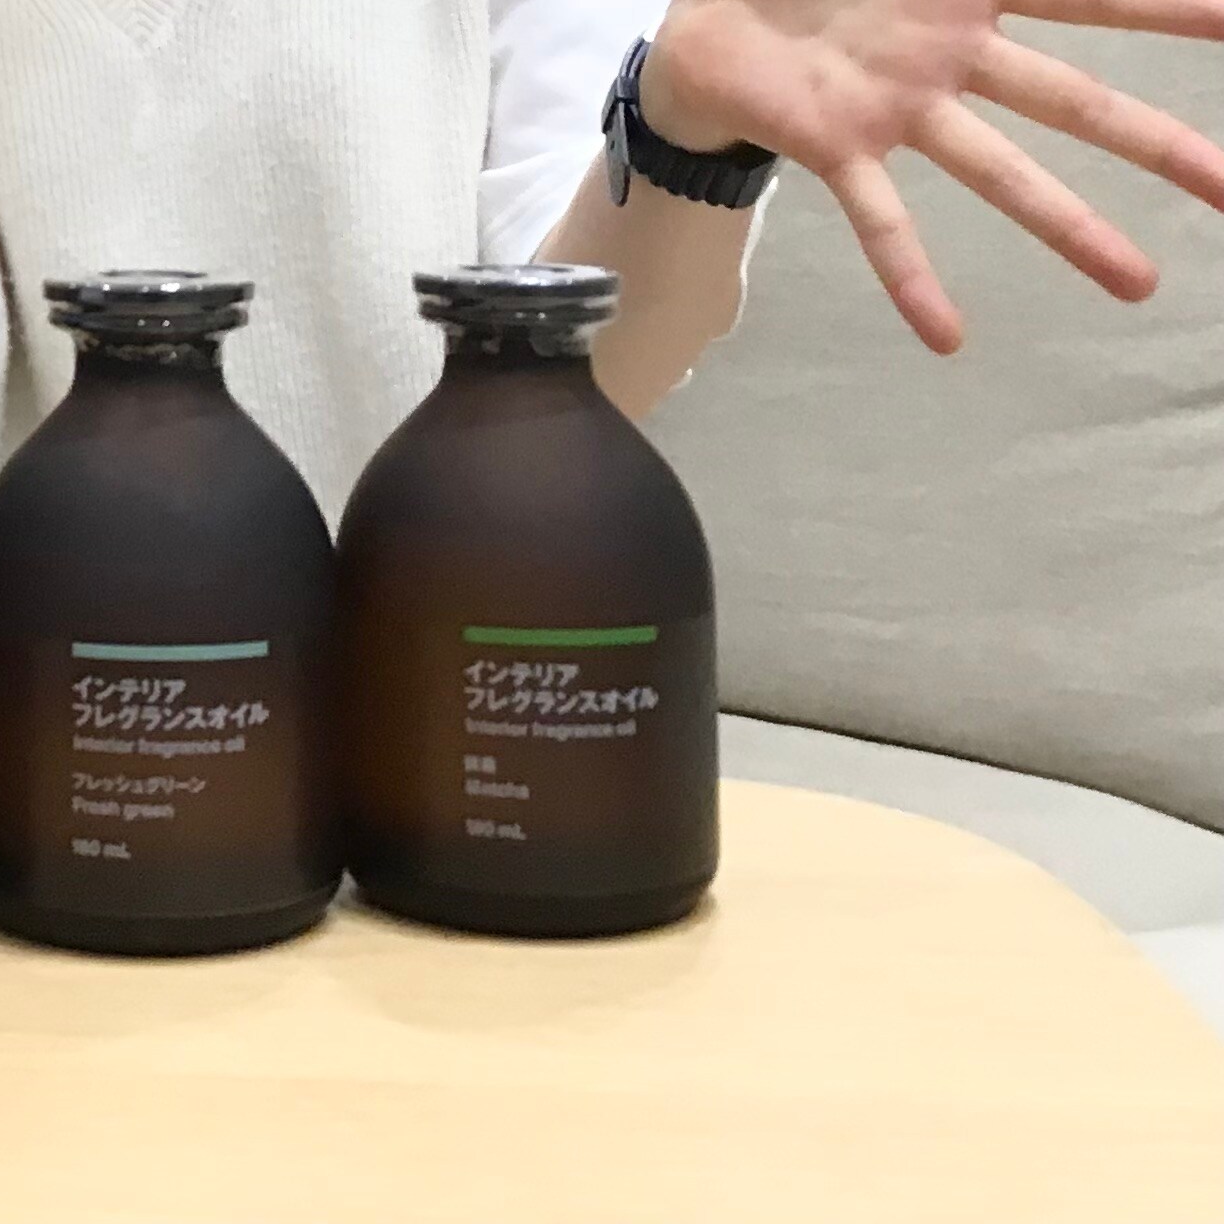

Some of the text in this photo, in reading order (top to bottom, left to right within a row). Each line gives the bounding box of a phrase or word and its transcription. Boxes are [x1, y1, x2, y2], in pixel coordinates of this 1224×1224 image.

[464, 659, 580, 687] インテリア
[72, 676, 187, 704] インテリア
[463, 685, 659, 716] フレグランスオイル
[72, 700, 270, 732] フレグランスオイル
